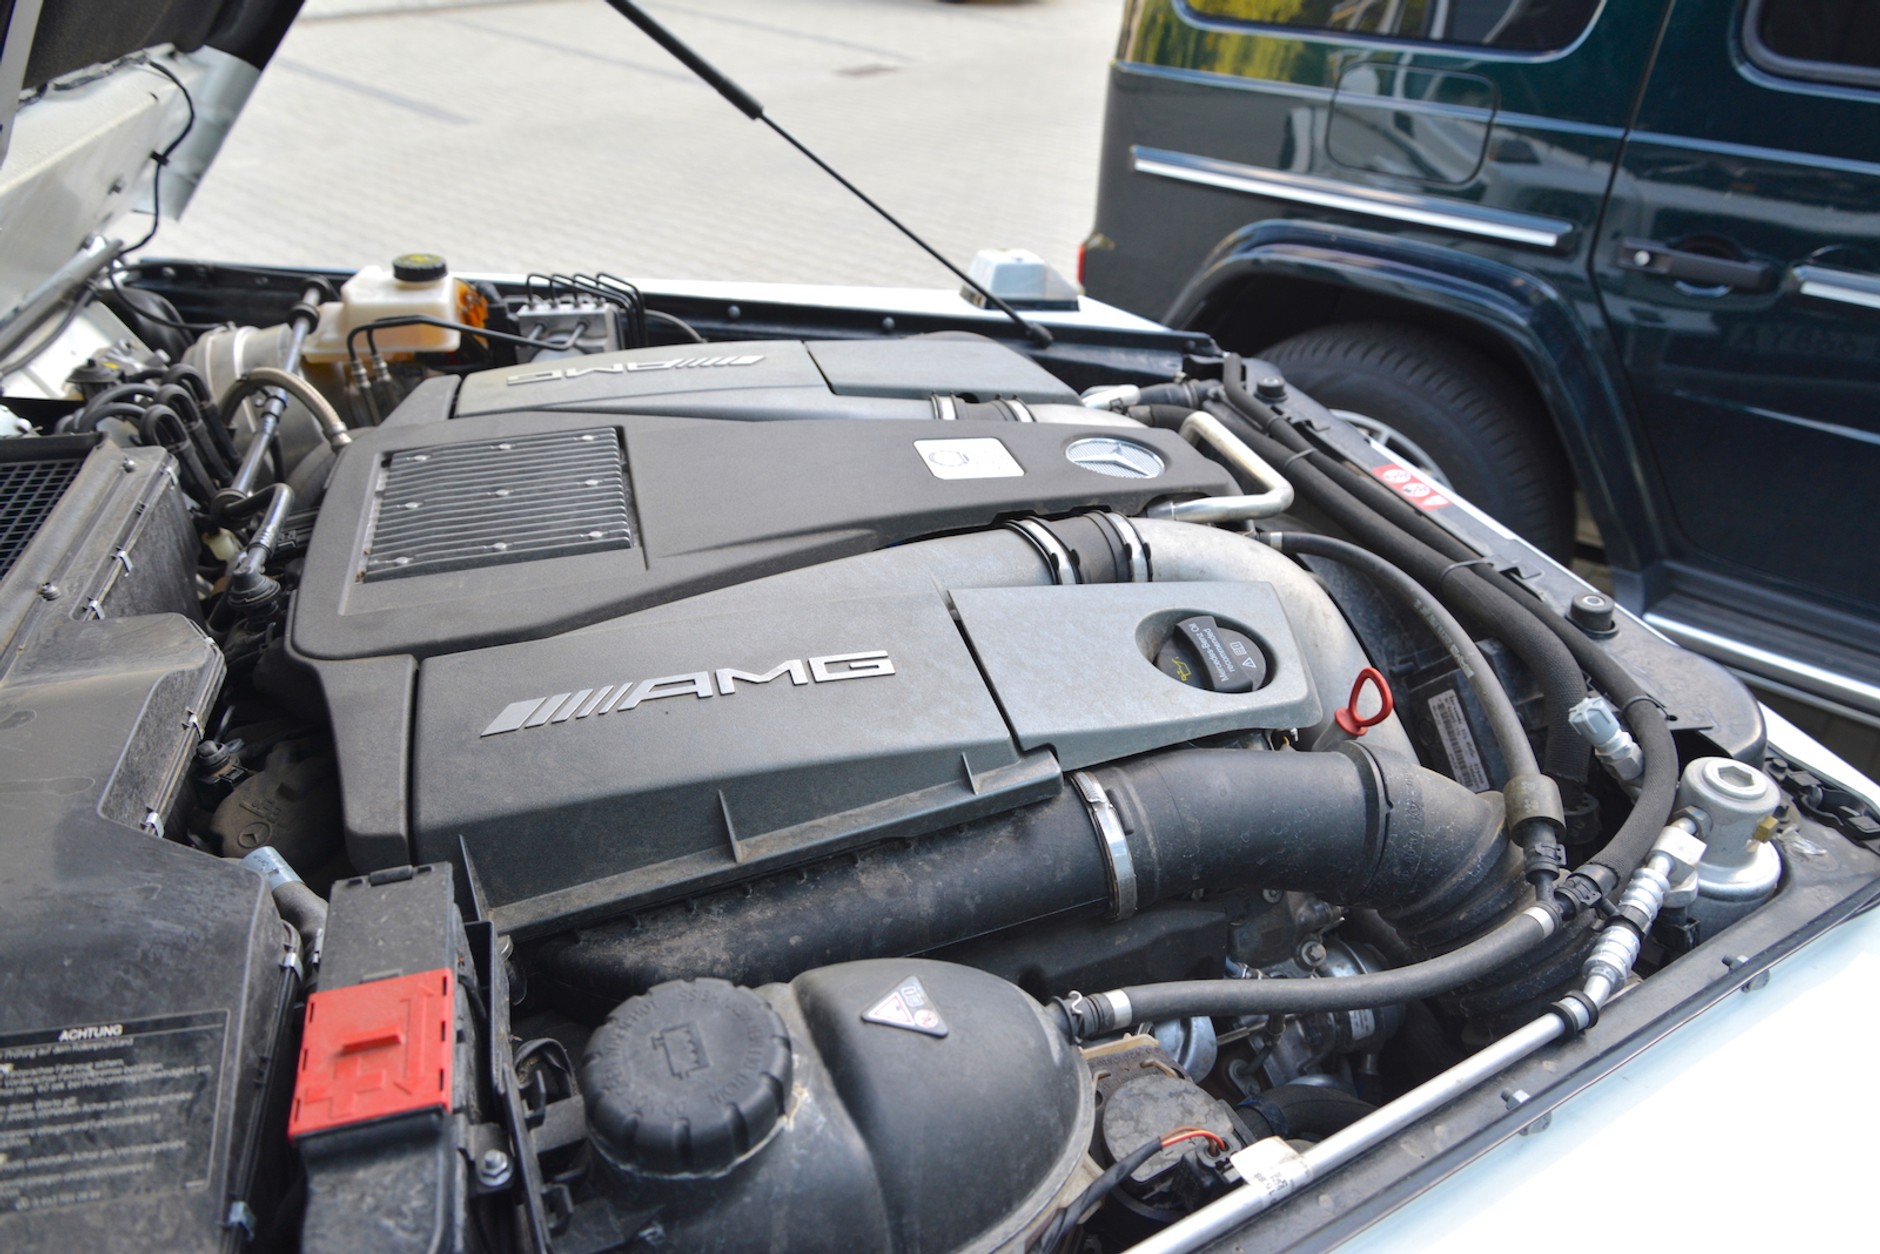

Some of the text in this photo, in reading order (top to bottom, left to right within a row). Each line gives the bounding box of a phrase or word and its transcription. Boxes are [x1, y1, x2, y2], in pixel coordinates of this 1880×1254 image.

[507, 358, 682, 385] AMG
[1188, 623, 1229, 682] Mercedes-Benz Oil
[1203, 628, 1236, 673] recommended
[618, 650, 896, 711] AMG
[58, 1024, 123, 1042] ACHTUNG
